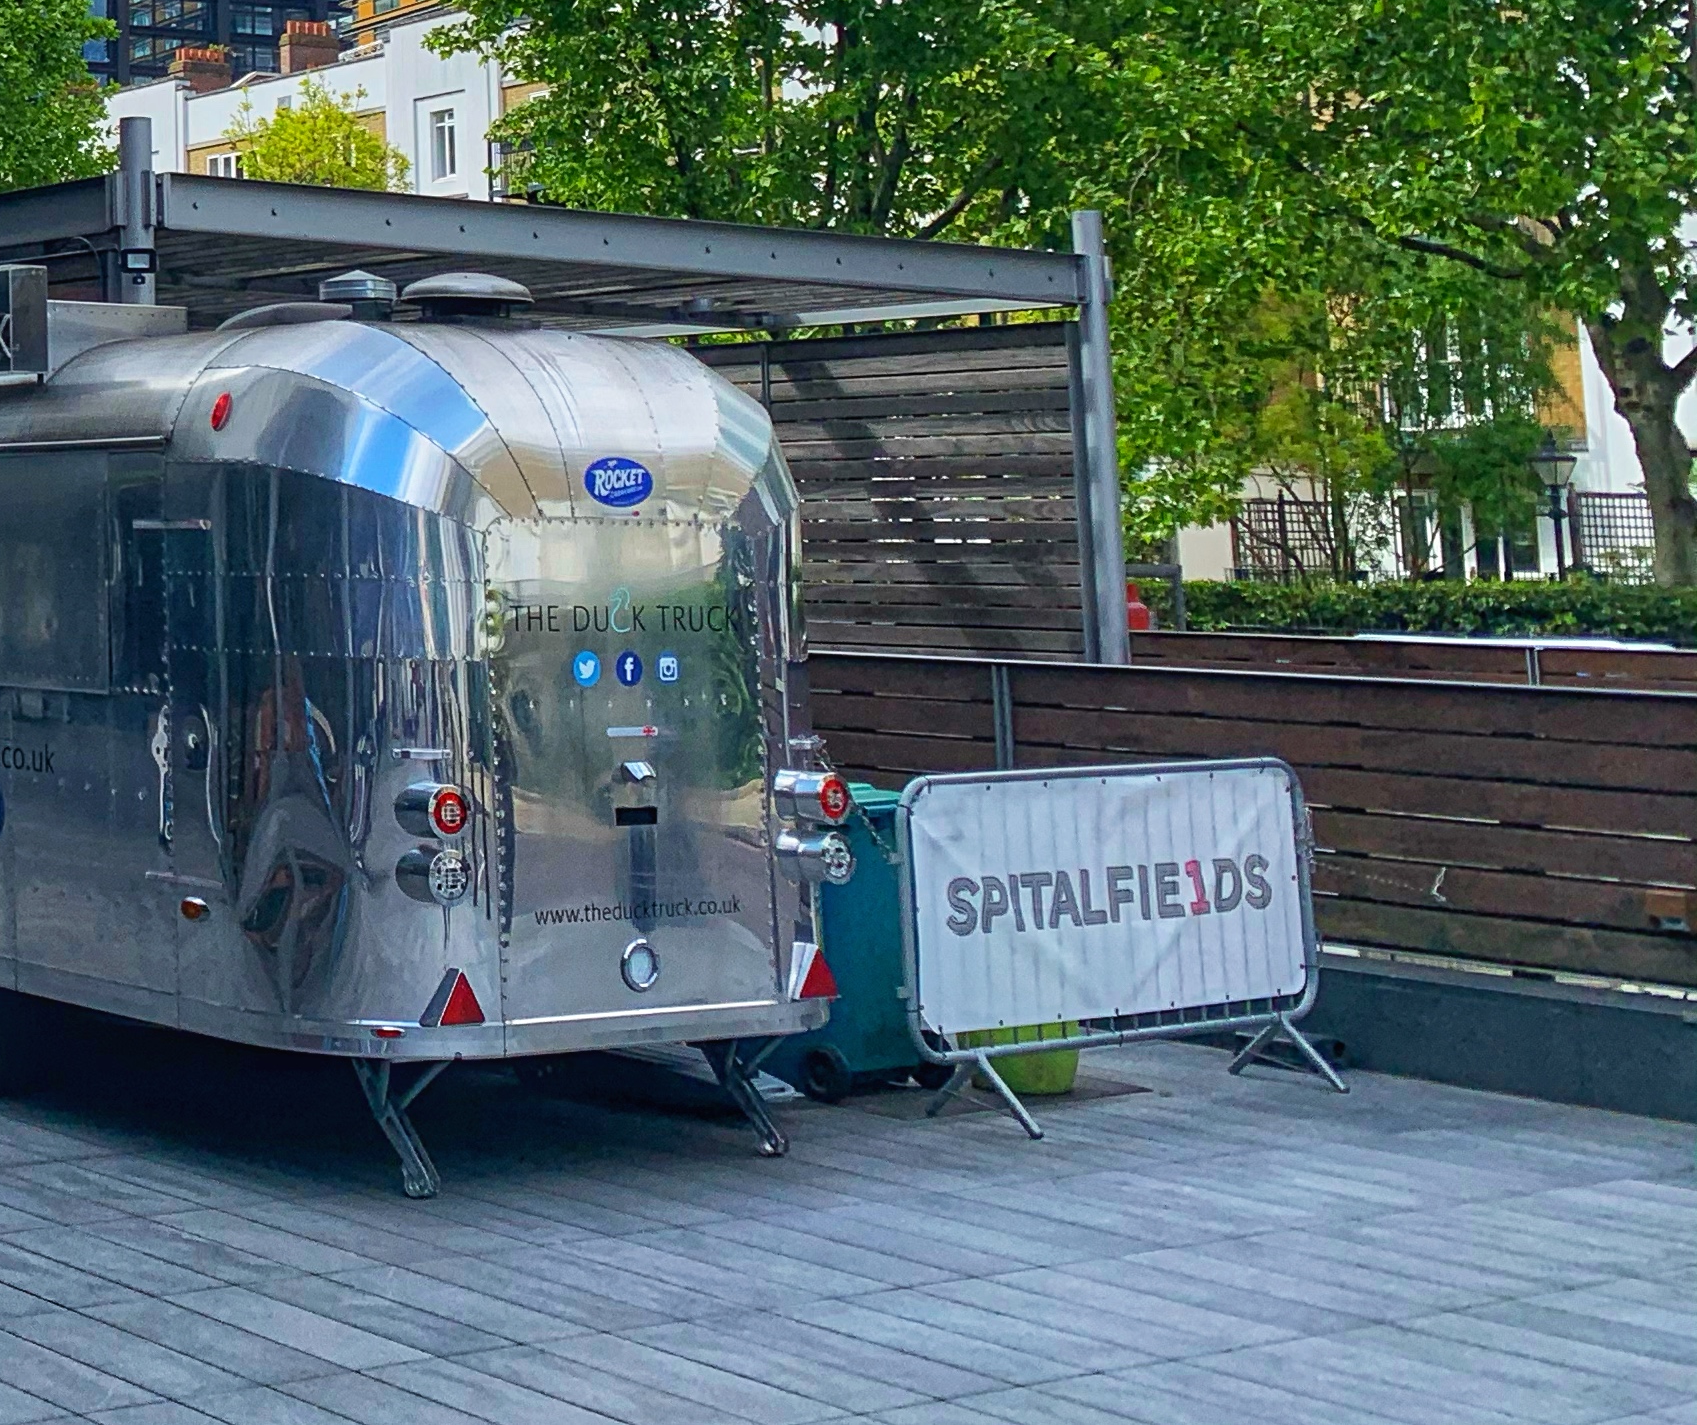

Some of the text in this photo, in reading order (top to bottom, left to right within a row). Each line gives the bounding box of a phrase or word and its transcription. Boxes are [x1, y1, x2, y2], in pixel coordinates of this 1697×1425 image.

[590, 468, 646, 497] ROCKET
[509, 587, 739, 633] THE DUCK TRUCK
[534, 894, 742, 925] www.theducktruck.co.uk
